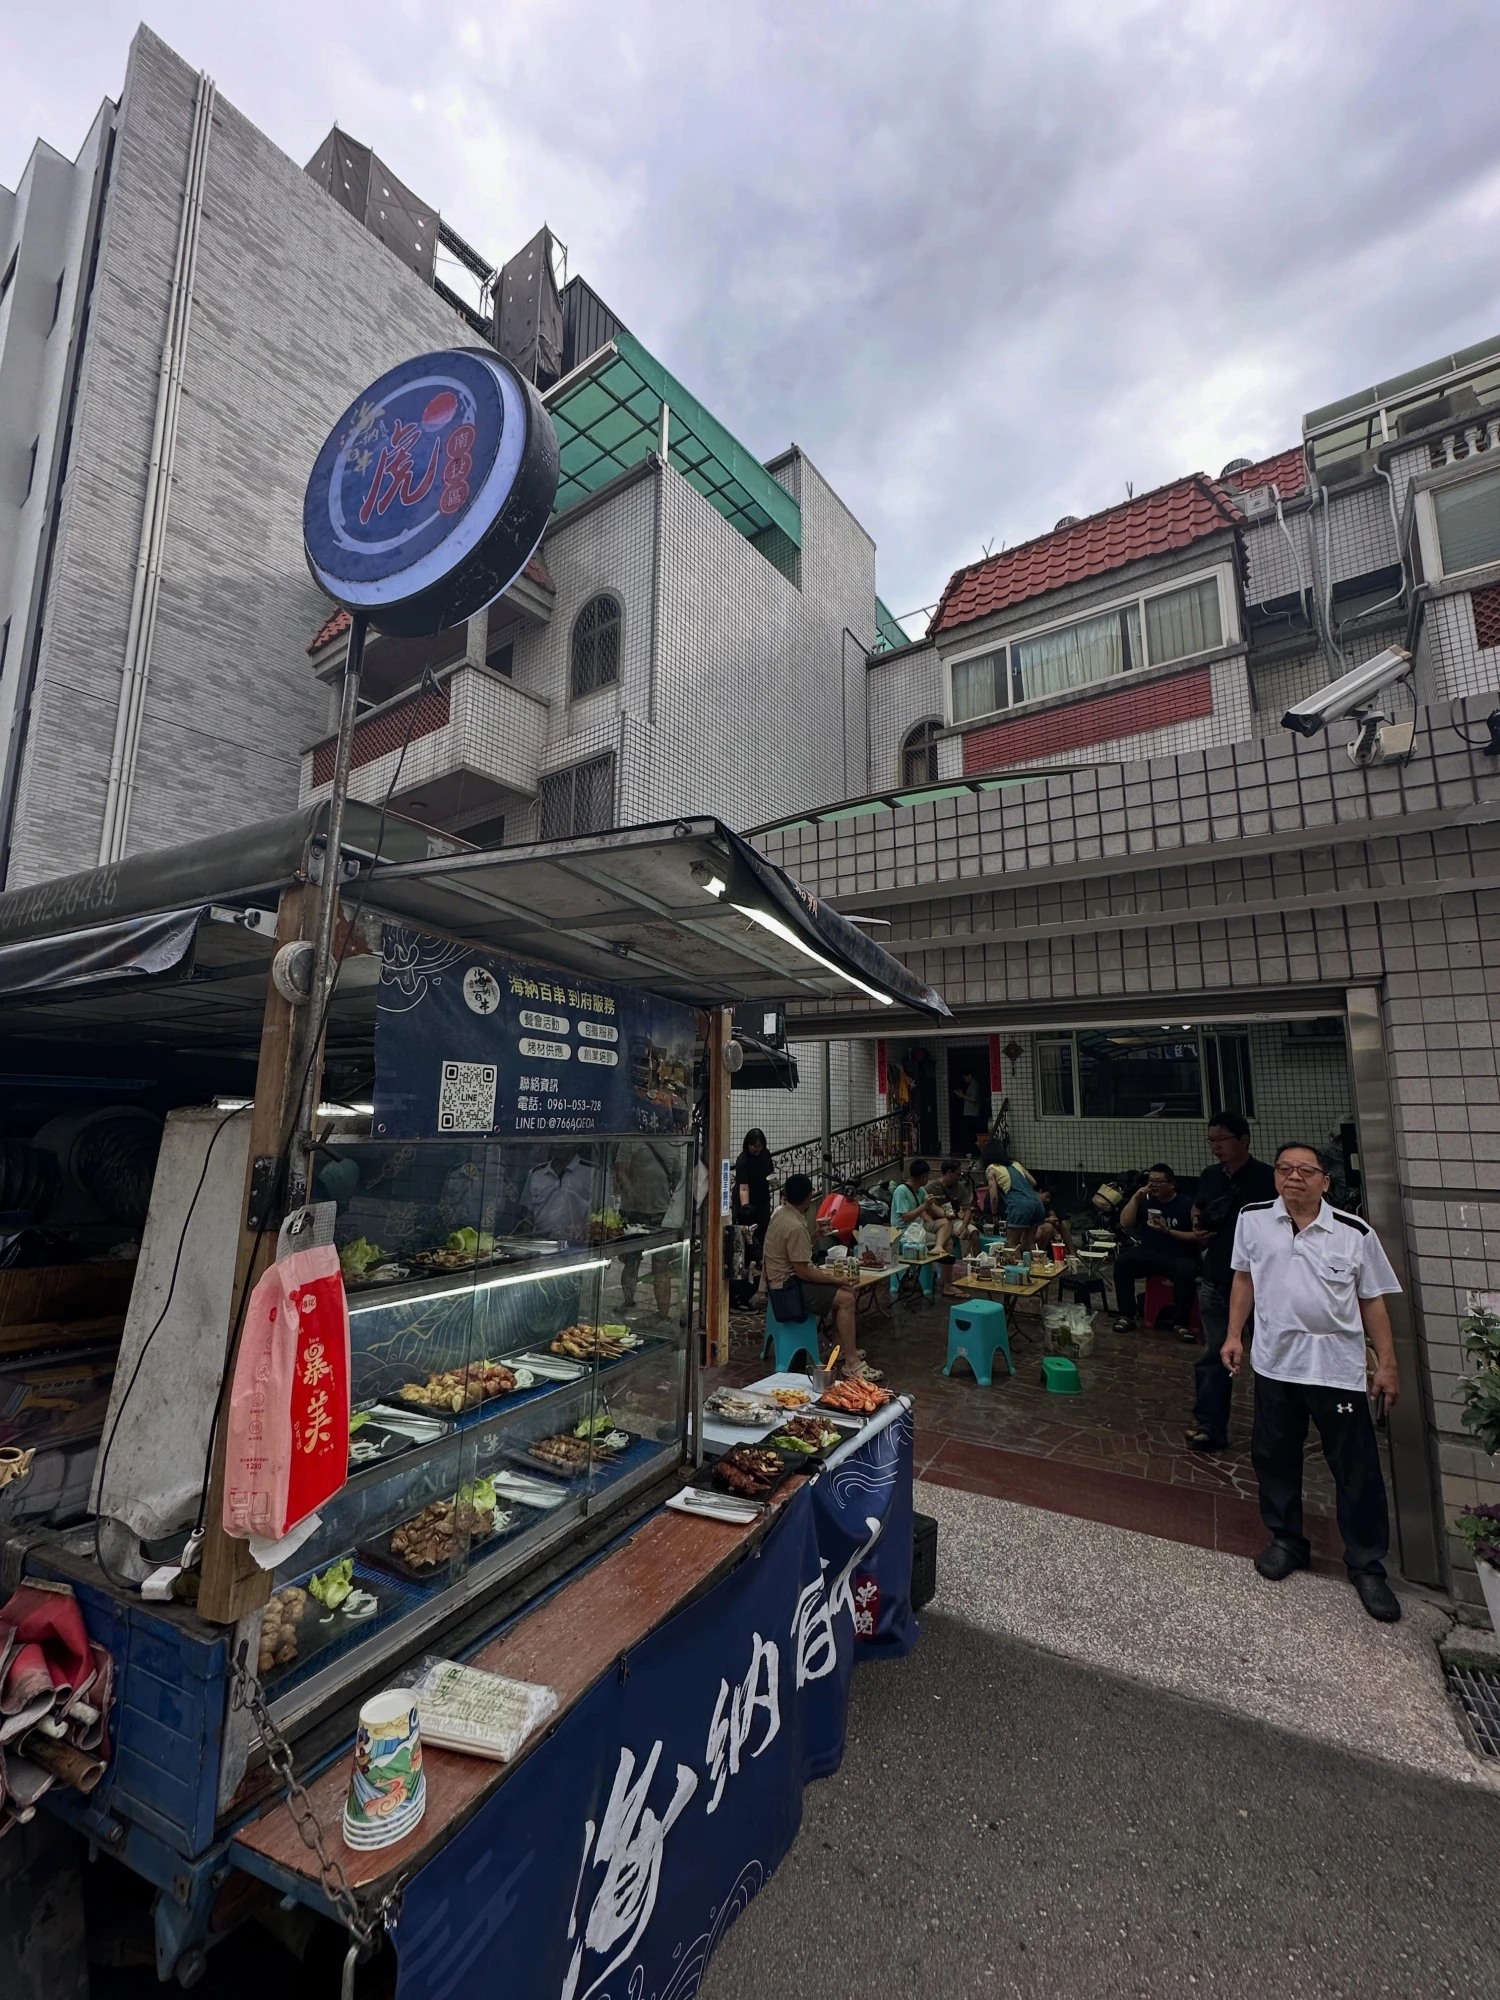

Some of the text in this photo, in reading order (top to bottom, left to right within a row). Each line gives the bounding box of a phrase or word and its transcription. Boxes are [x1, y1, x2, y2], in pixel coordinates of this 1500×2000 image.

[447, 431, 469, 507] 南投區
[508, 974, 616, 1015] 海納百串 到府服務
[524, 1012, 560, 1032] 餐會活動
[527, 1040, 564, 1058] 烤材供應
[583, 1048, 614, 1064] 創業培訓
[518, 1075, 559, 1093] 聯絡資訊
[547, 1098, 602, 1112] 0961-053-728
[515, 1117, 534, 1129] LINE
